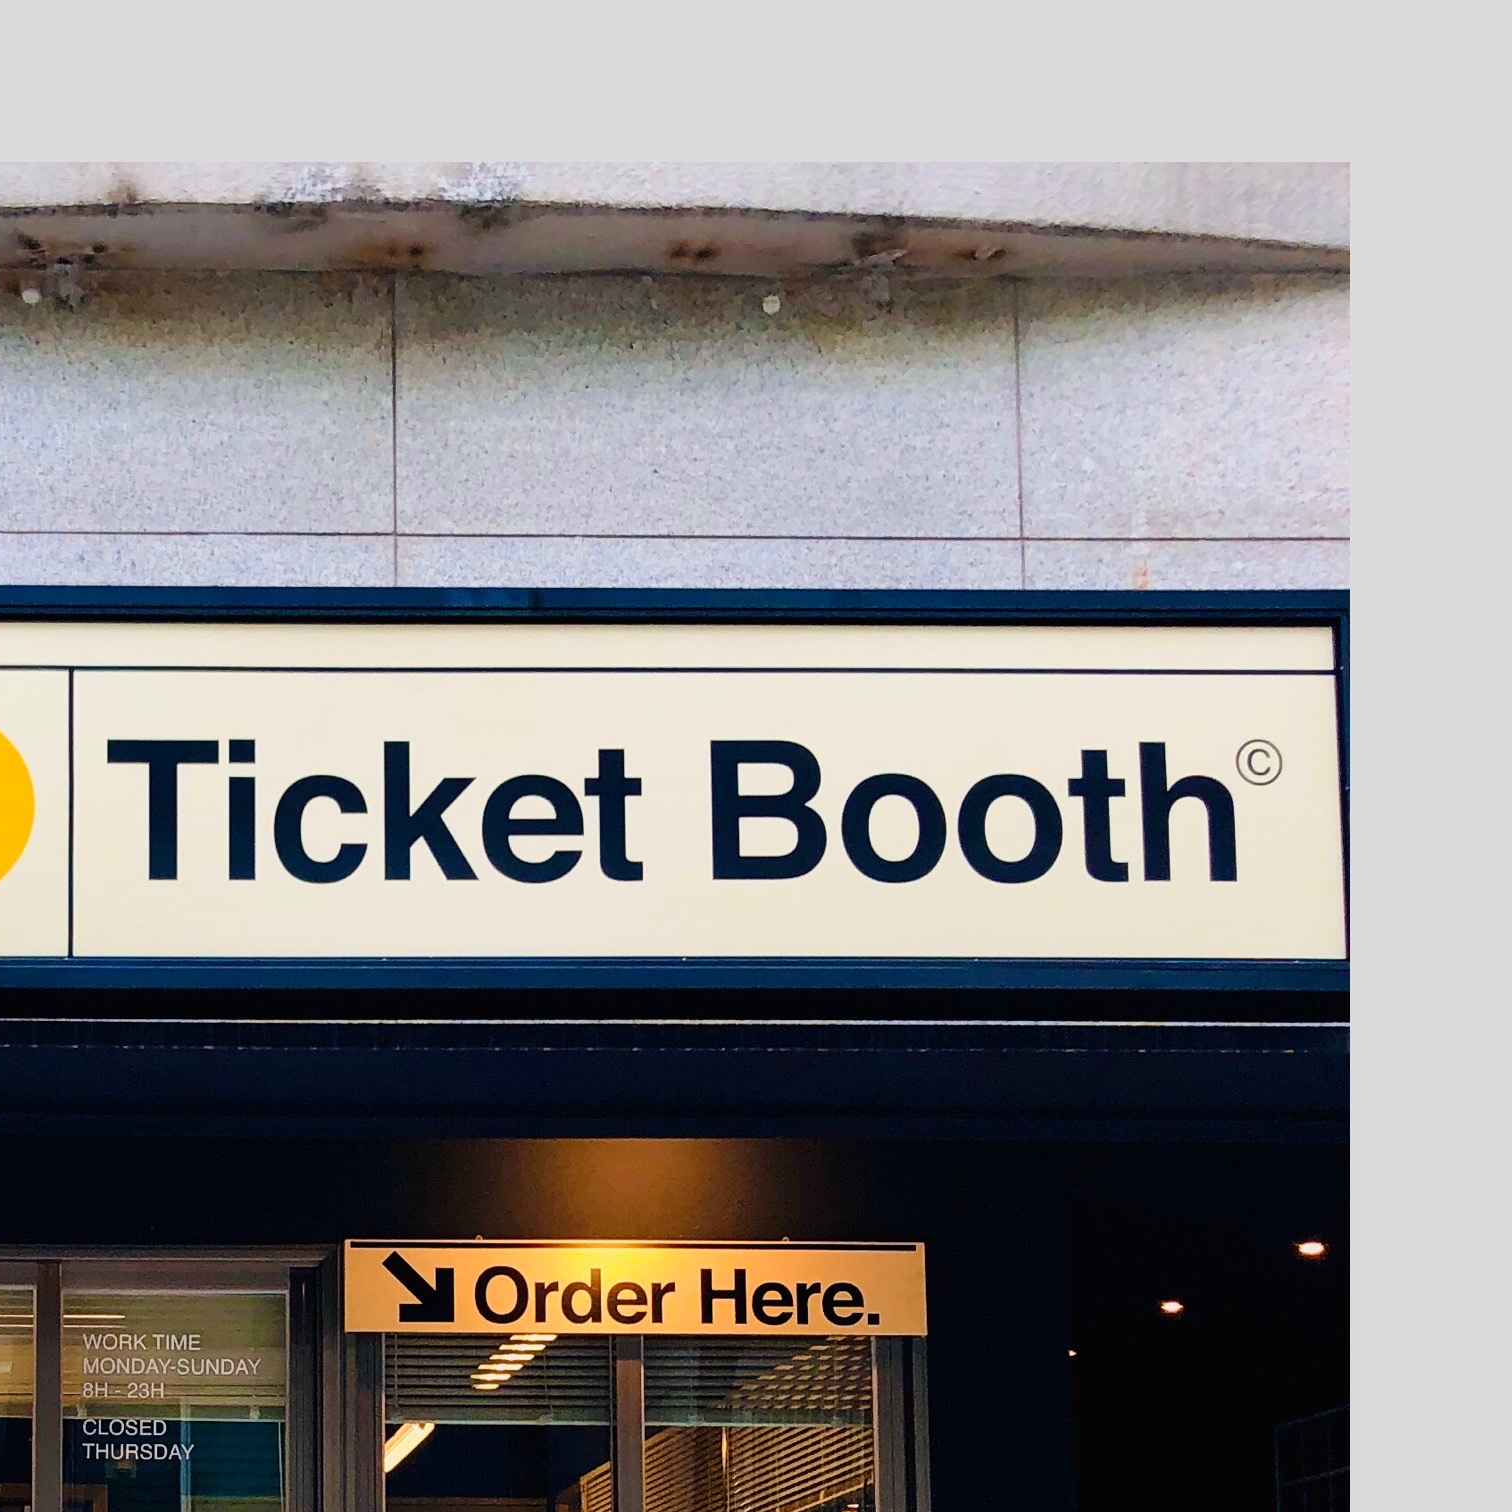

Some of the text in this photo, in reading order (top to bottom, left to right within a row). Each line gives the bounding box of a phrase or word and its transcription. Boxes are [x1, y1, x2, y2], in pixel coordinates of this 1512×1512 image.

[107, 739, 644, 884] Ticket
[474, 1265, 880, 1326] Order Here.
[83, 1333, 201, 1351] WORK TIME
[83, 1357, 262, 1376] MONDAY-SUNDAY
[83, 1382, 108, 1399] 8H
[127, 1382, 165, 1399] 23H
[82, 1418, 167, 1436] CLOSED
[82, 1442, 195, 1461] THURSDAY
